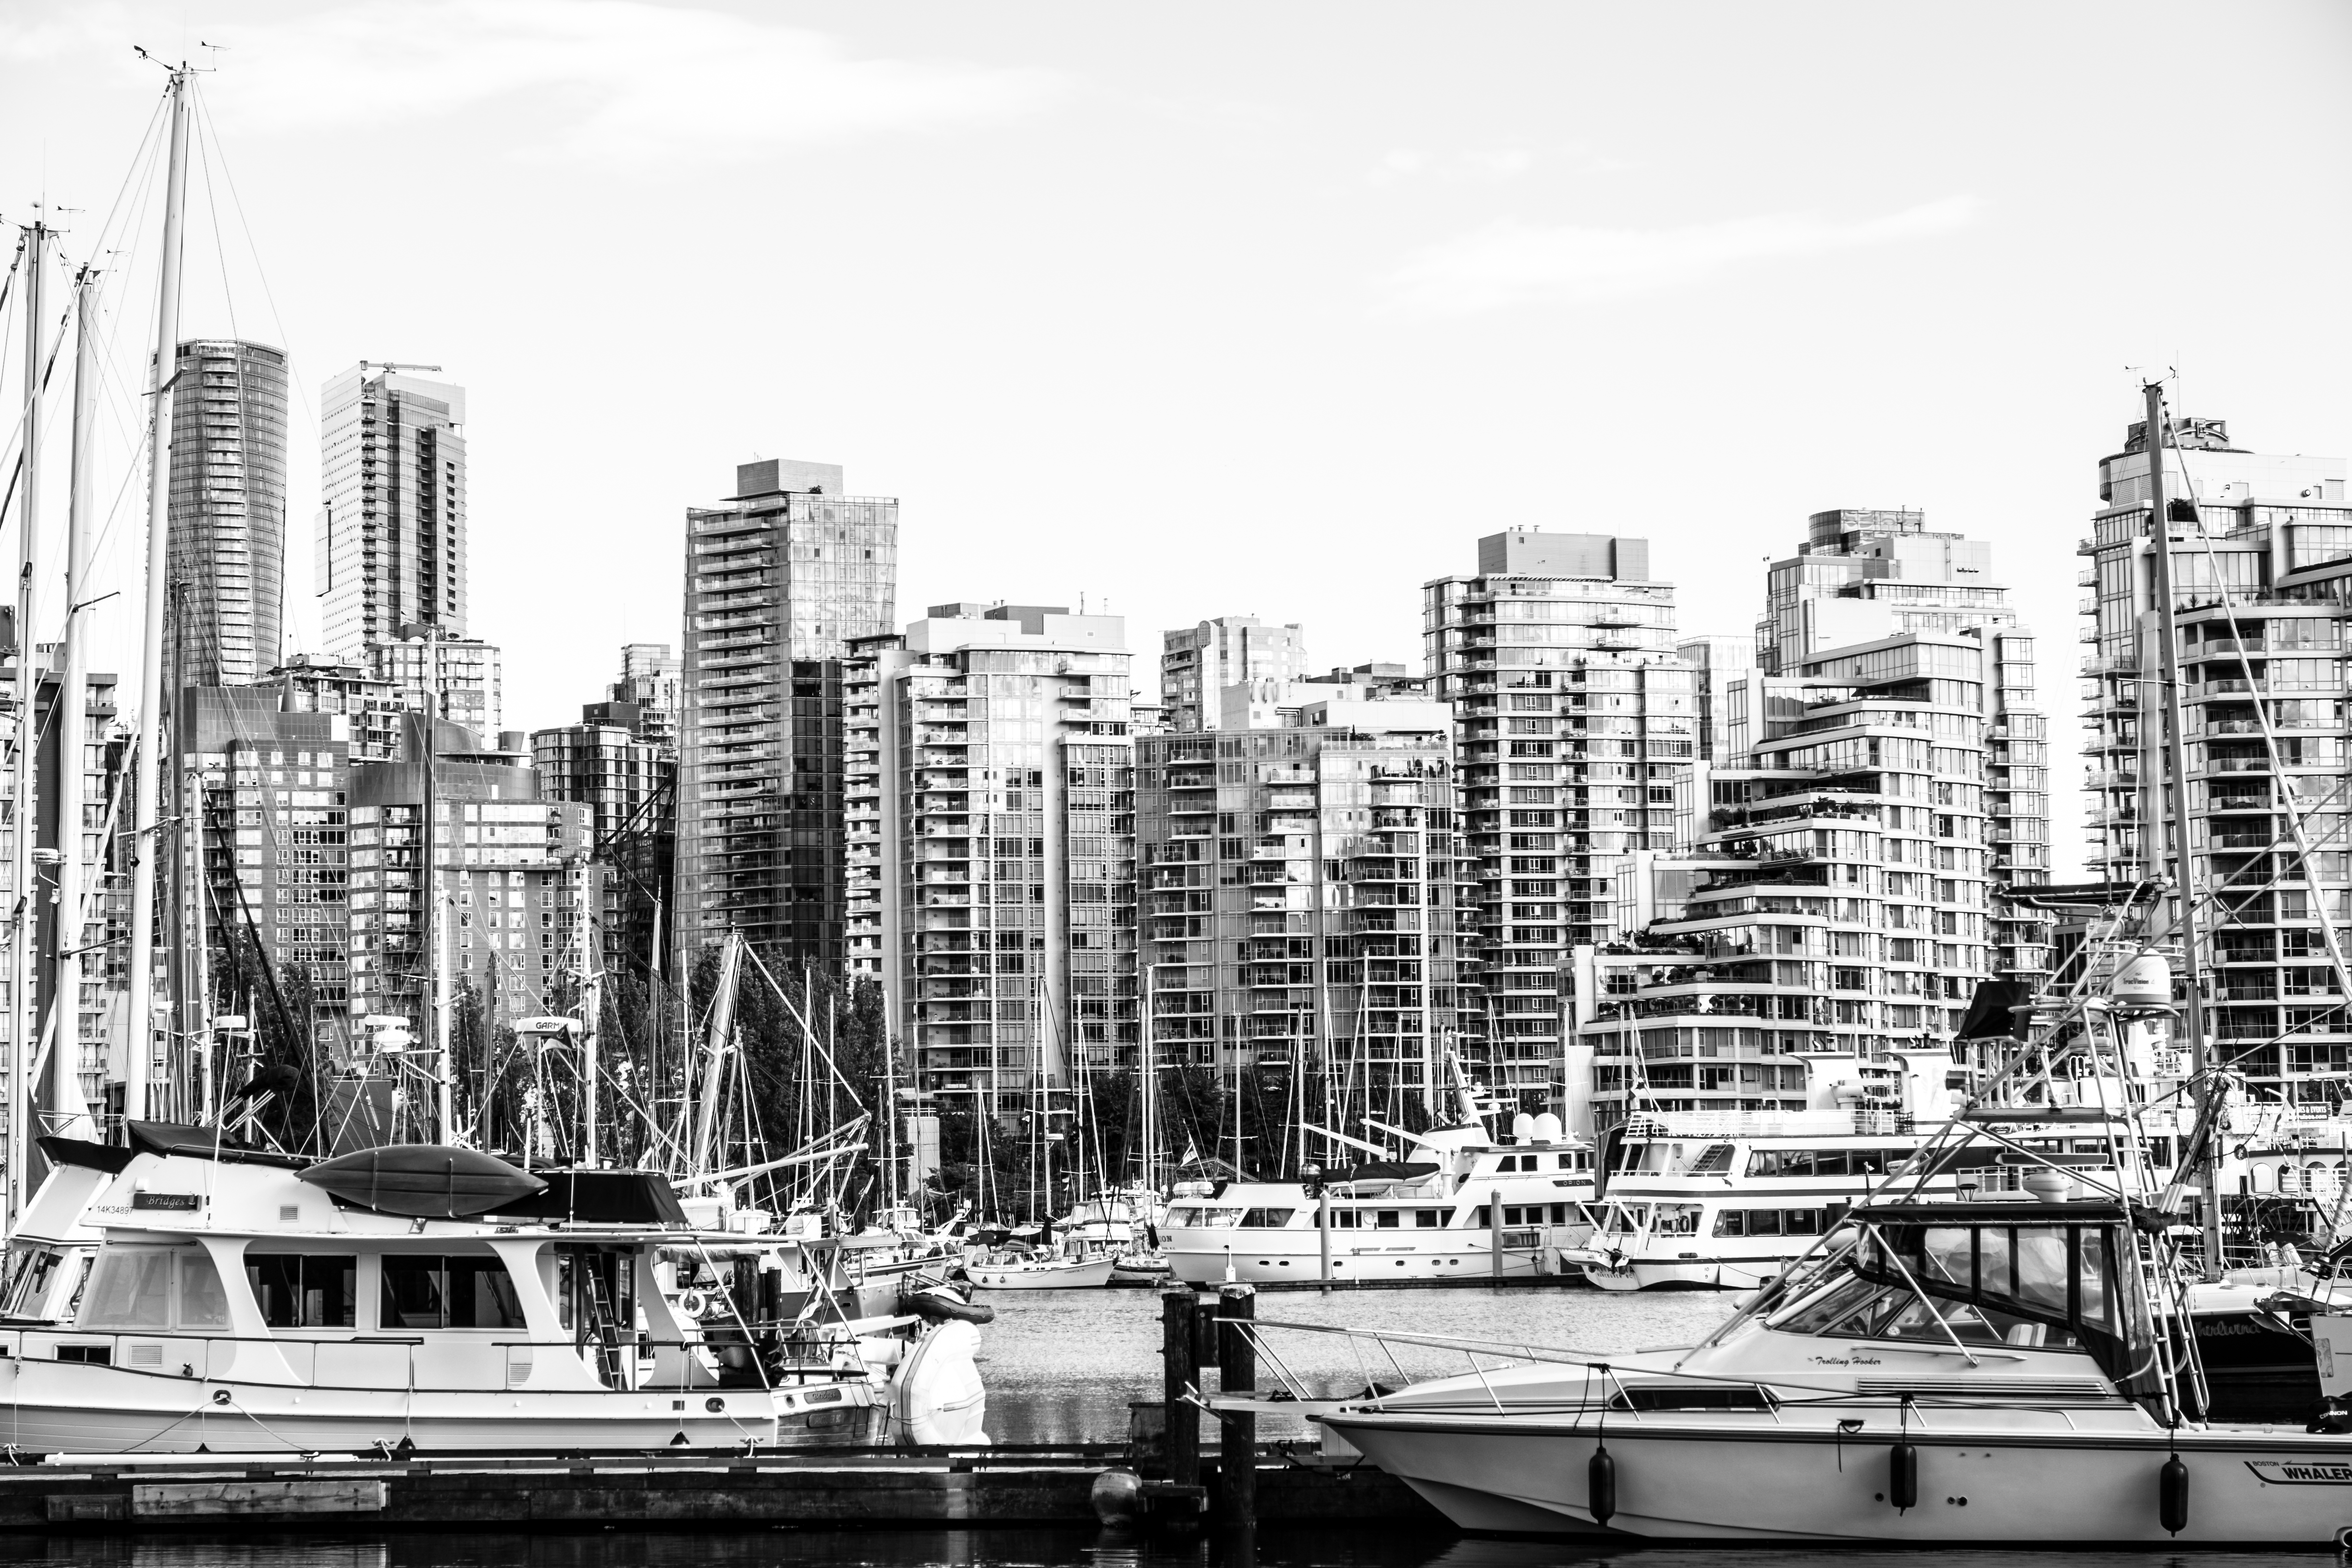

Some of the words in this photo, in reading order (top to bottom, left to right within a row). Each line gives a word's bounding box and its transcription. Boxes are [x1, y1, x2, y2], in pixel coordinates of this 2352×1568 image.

[146, 1195, 185, 1209] Bridges
[97, 1206, 133, 1214] 14K34897
[1815, 1356, 1849, 1368] Trolling
[1852, 1356, 1882, 1365] Hooker
[812, 1391, 836, 1401] Bridges
[814, 1415, 835, 1425] VANCOUER
[2281, 1467, 2352, 1481] WHALER
